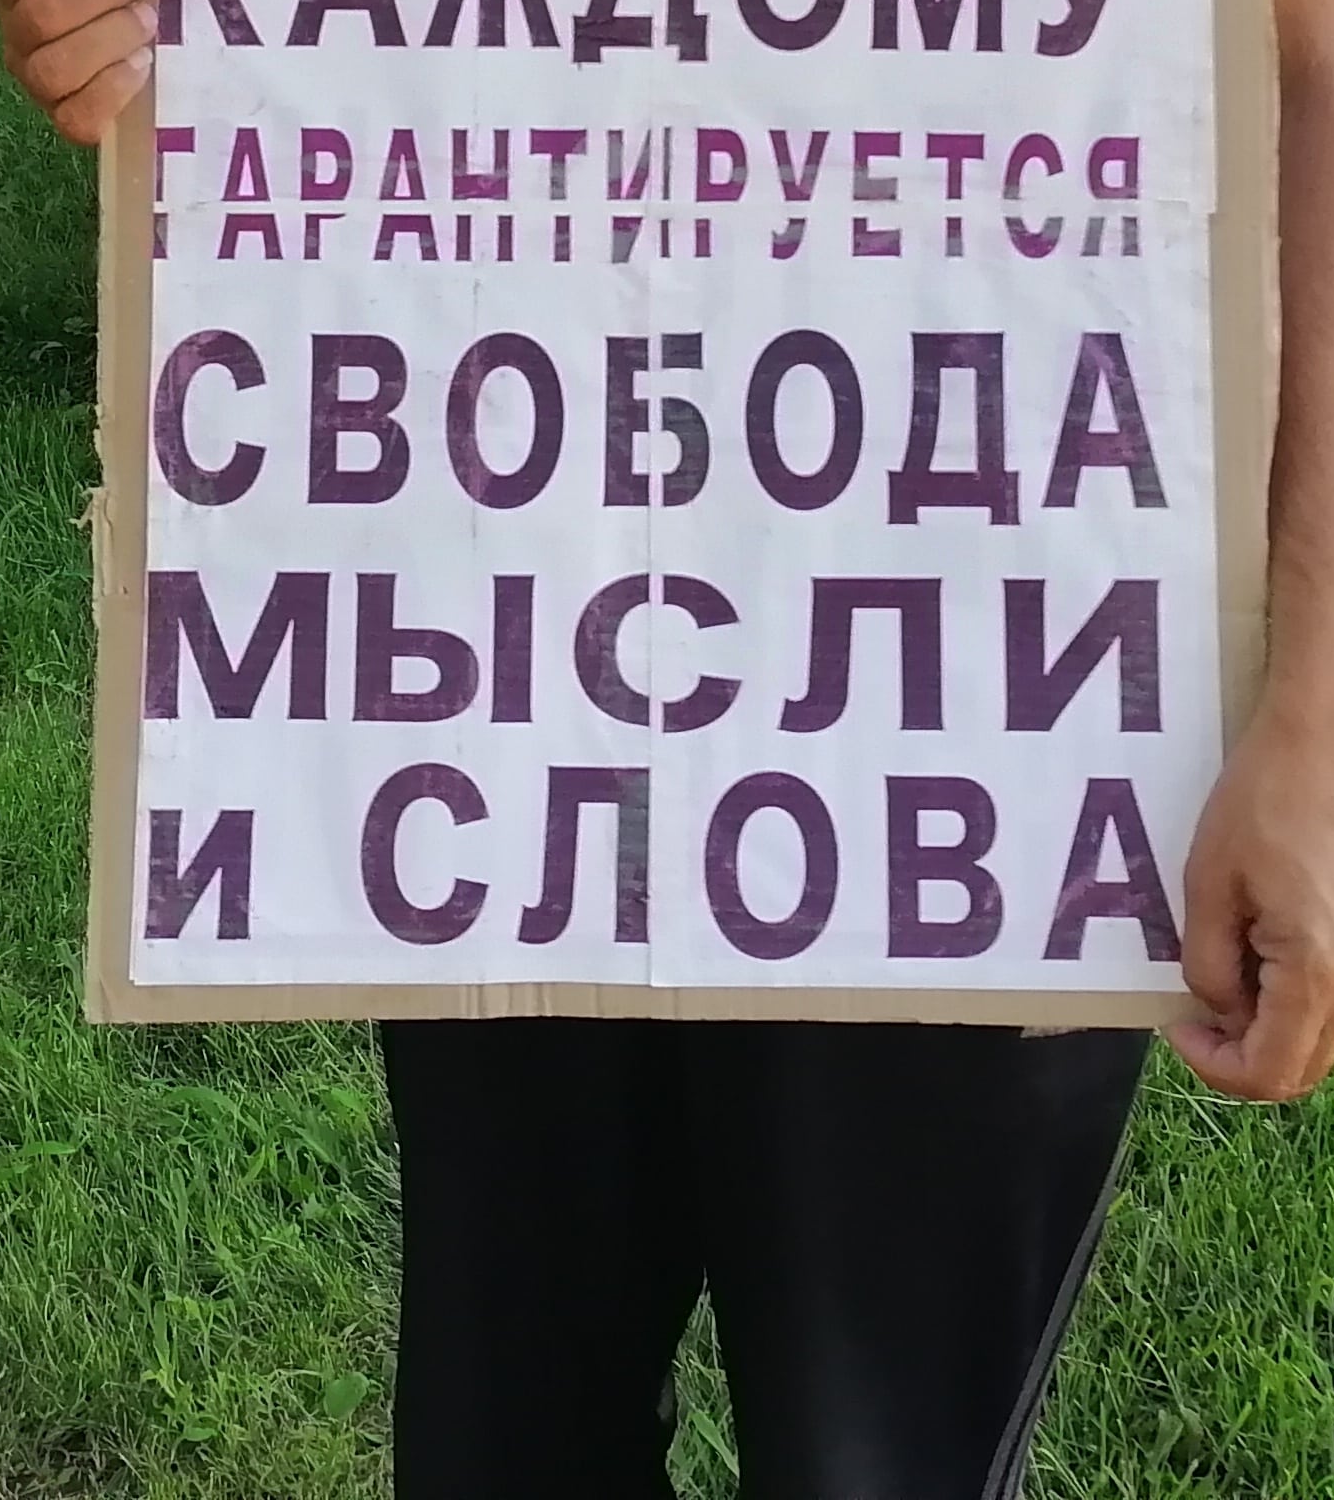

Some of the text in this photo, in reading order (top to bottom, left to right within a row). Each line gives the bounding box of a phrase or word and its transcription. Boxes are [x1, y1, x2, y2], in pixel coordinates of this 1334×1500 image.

[153, 127, 1141, 263] ГАРАНТИРУЕТСЯ
[154, 329, 1169, 526] СВОБОДА
[144, 570, 1164, 733] МЫСЛИ
[144, 762, 1183, 962] и СЛОВА
